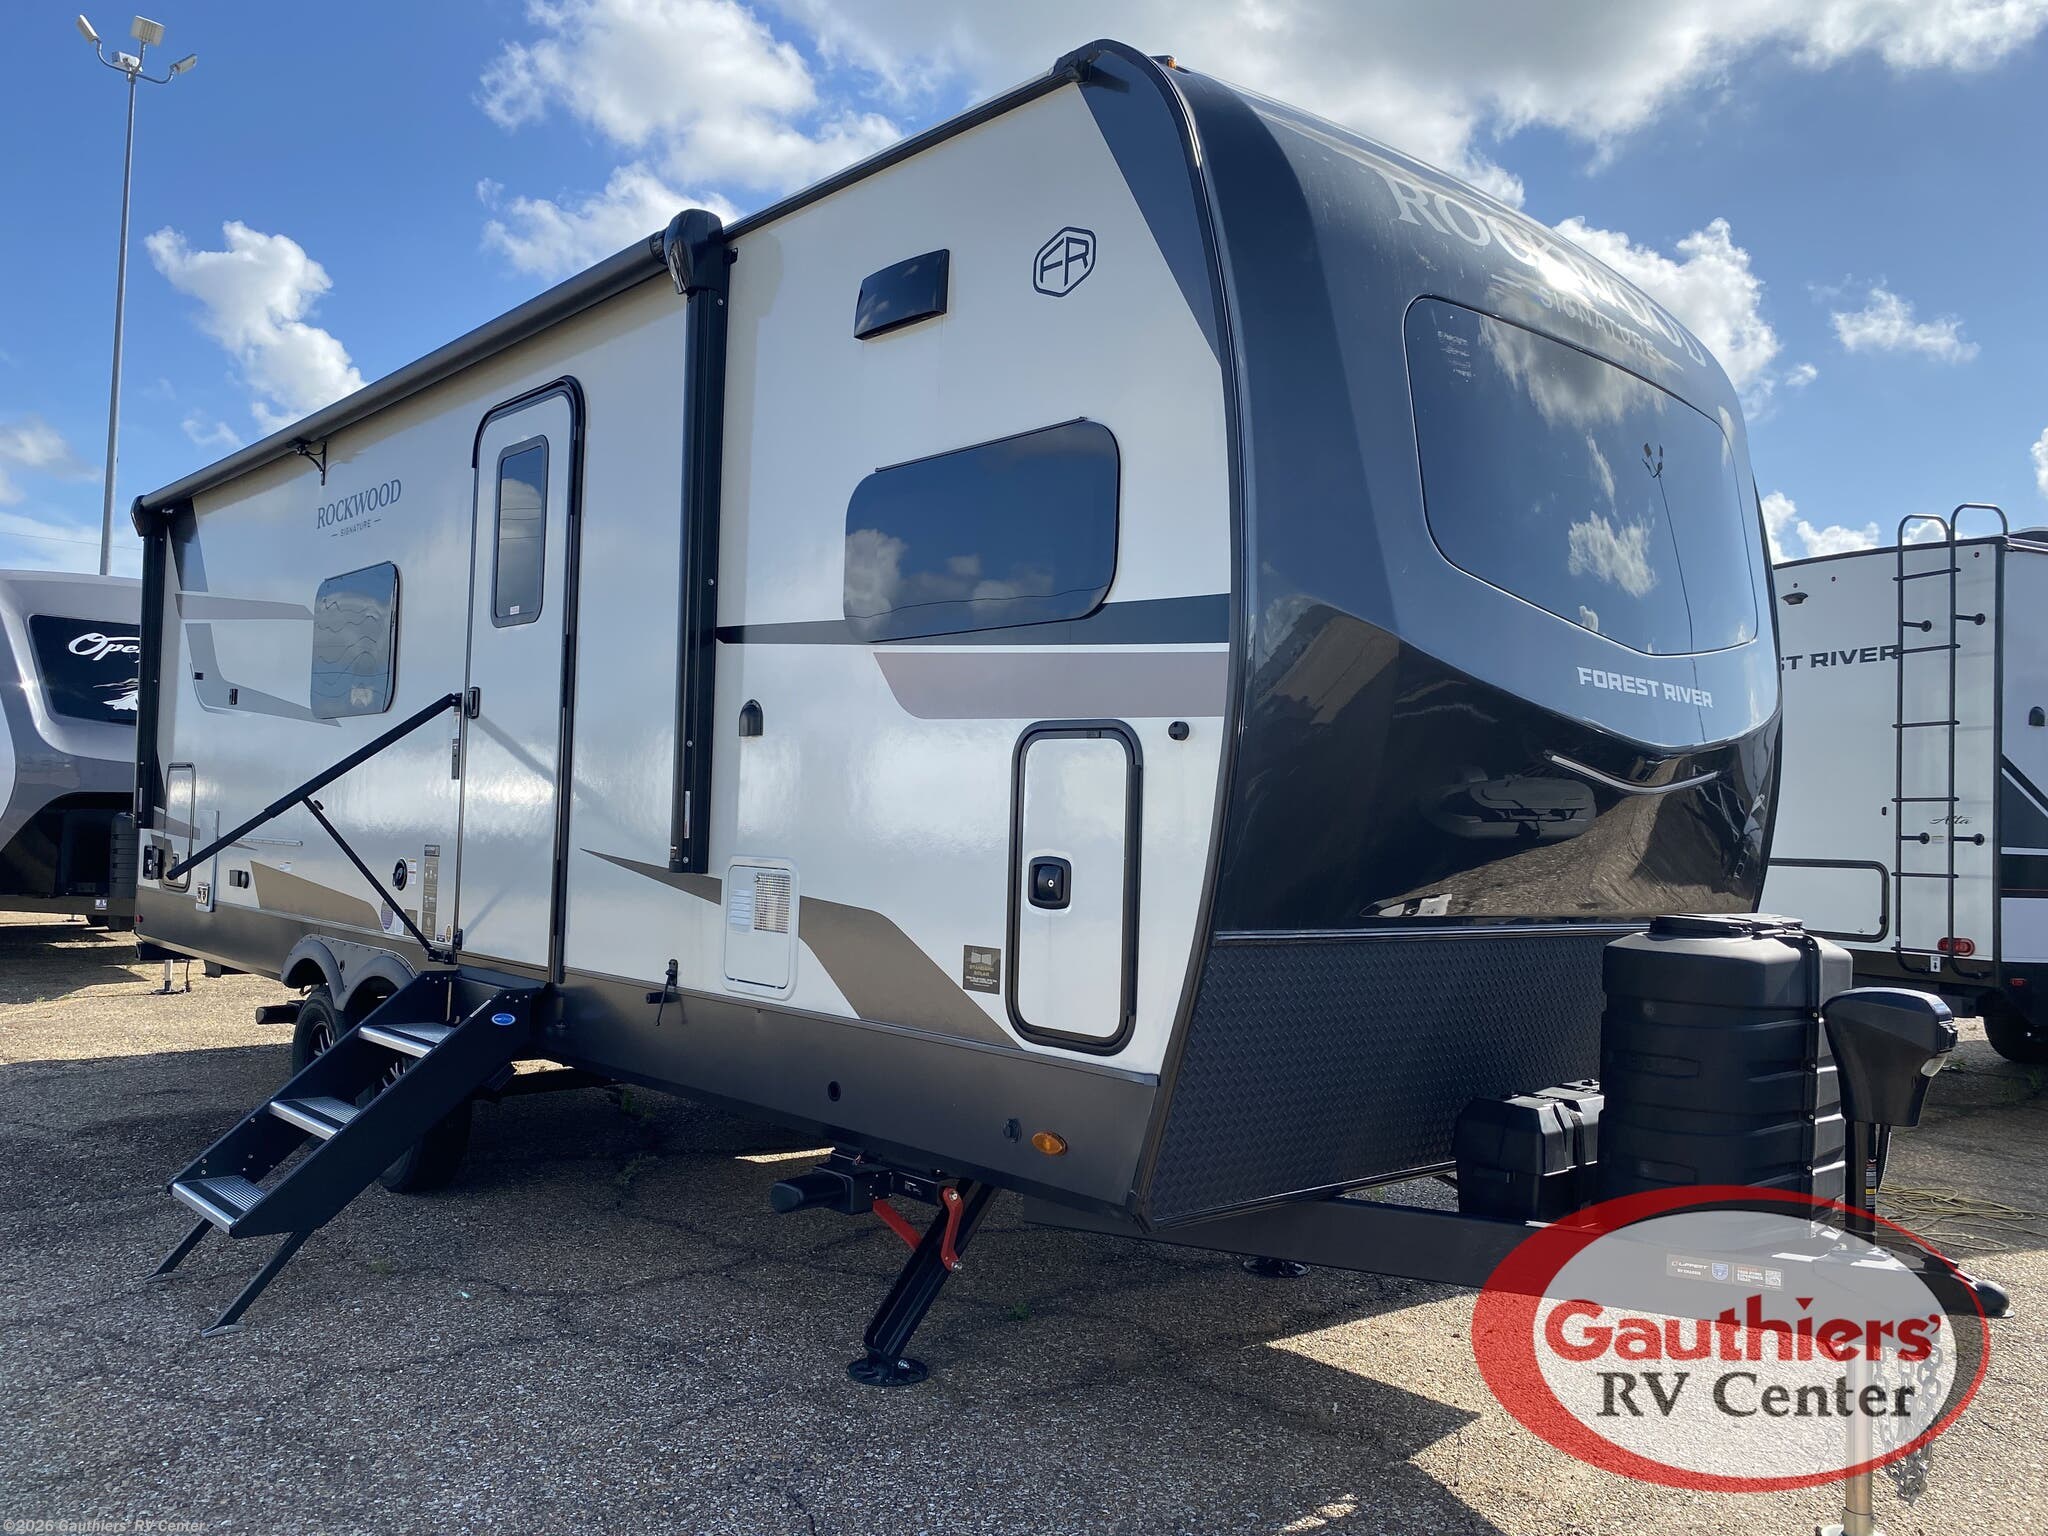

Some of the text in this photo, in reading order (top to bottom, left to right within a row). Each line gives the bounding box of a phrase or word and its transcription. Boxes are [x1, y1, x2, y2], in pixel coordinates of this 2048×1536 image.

[1538, 285, 1659, 359] SIGNATURE
[316, 478, 402, 530] ROCKWOOD
[339, 518, 372, 538] SIGNATURE
[68, 632, 141, 661] Ope
[1809, 644, 1901, 669] RIVER
[1576, 666, 1713, 709] FOREST RIVER
